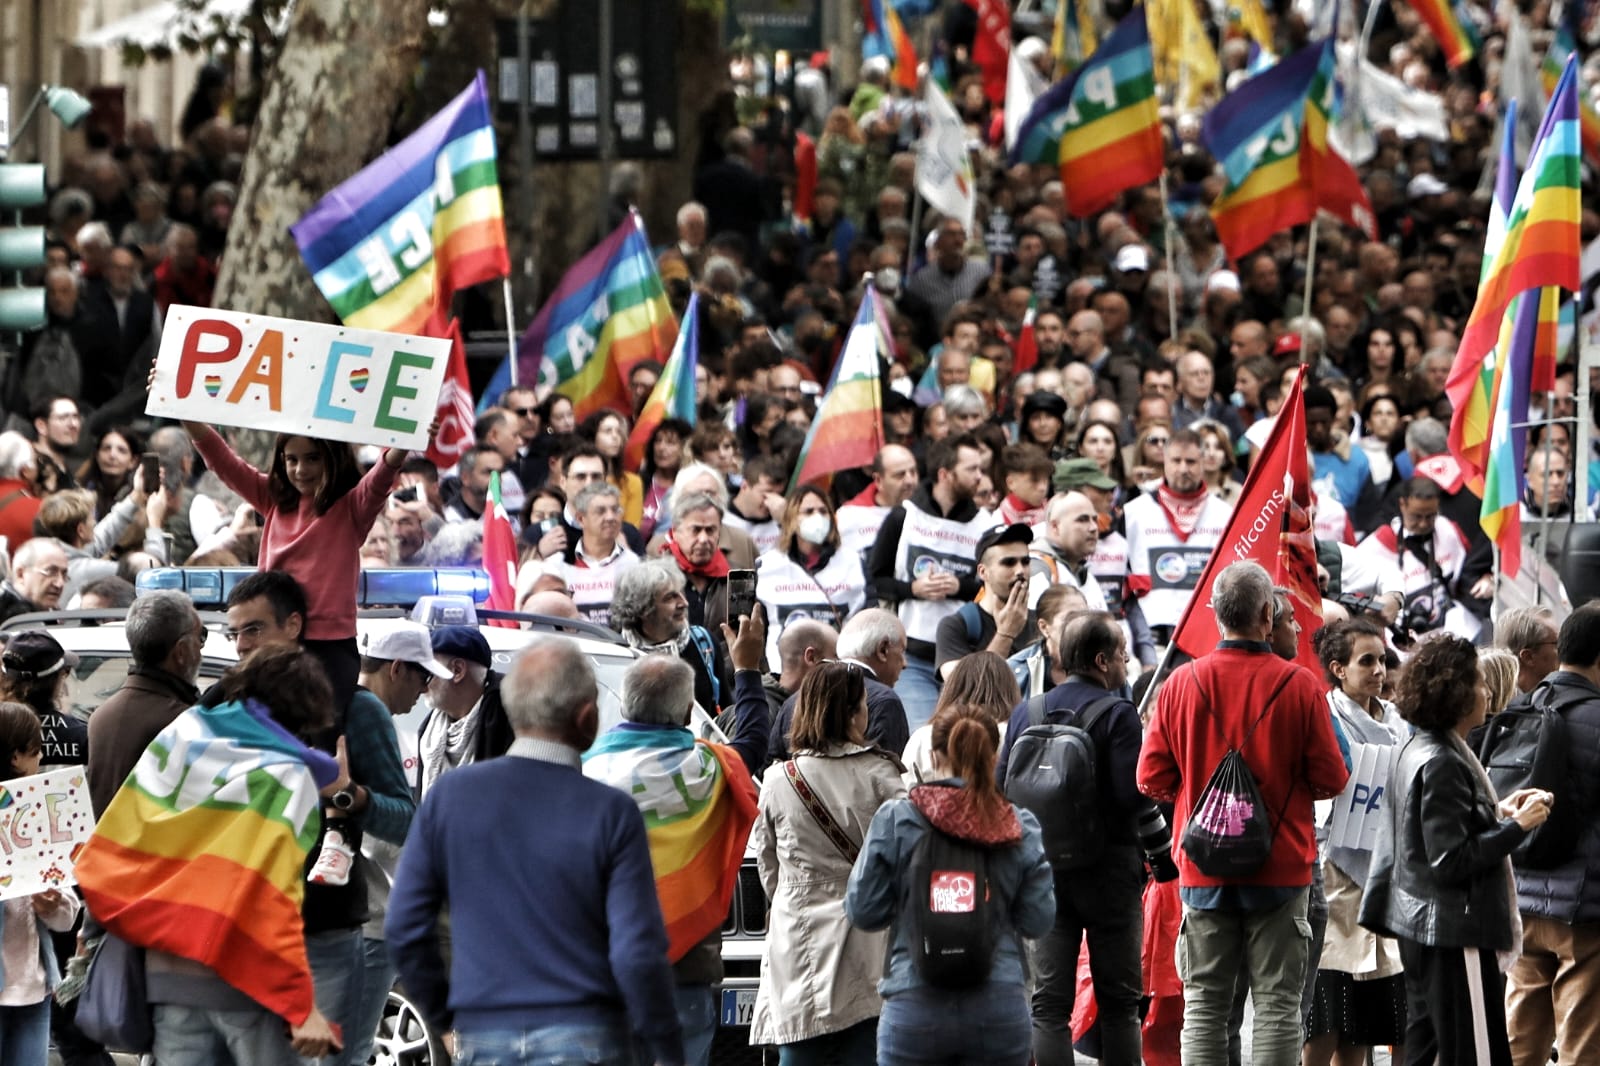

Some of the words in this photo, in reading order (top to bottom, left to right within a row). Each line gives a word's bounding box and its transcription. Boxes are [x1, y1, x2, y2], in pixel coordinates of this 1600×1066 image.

[175, 318, 435, 435] PACE
[1233, 489, 1285, 561] filcams
[738, 1003, 754, 1024] YA
